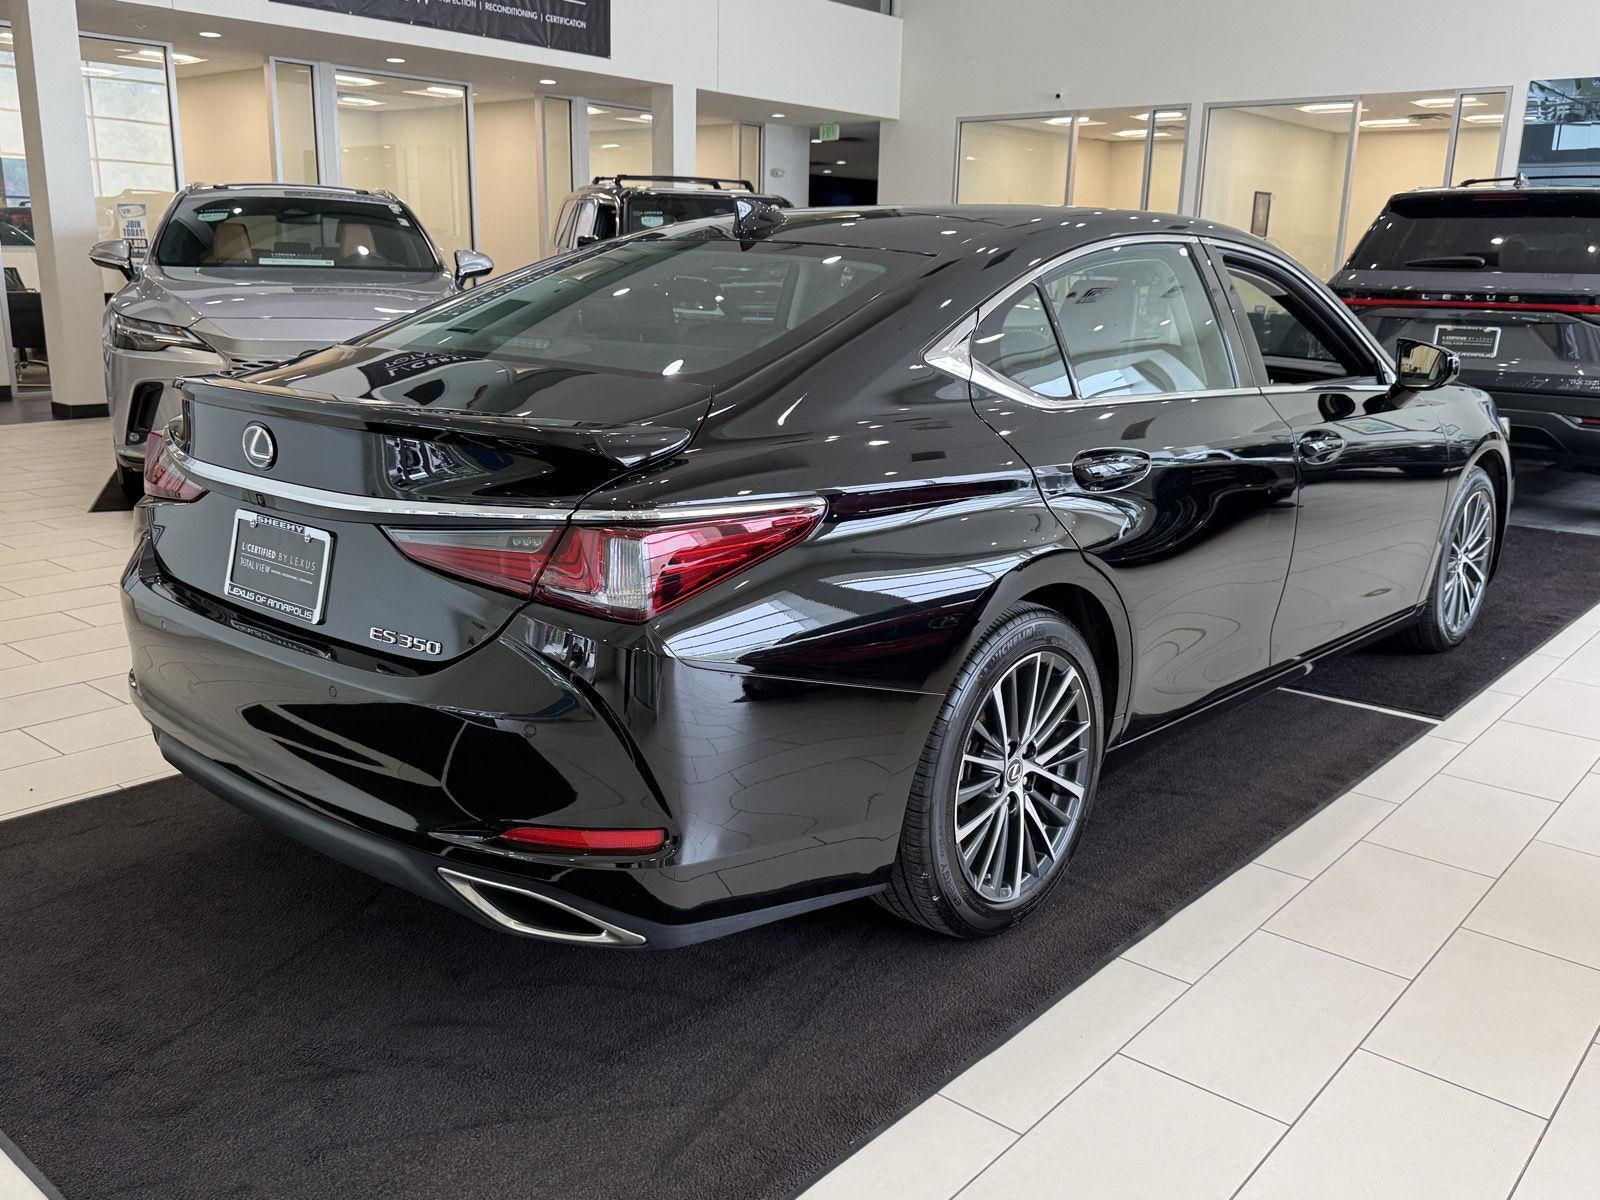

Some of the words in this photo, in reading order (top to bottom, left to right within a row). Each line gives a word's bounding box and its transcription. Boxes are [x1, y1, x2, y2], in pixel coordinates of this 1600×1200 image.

[485, 3, 538, 20] RECONDITIONING
[546, 14, 587, 29] CERTIFICATION
[126, 220, 142, 229] JOIN
[1421, 293, 1519, 302] LEXUS
[257, 515, 304, 533] SHEEHY
[255, 562, 271, 574] VIEW
[278, 553, 288, 562] BY
[290, 556, 316, 571] LEXUS
[228, 585, 255, 600] LEXUS
[255, 592, 267, 604] OF
[267, 598, 312, 620] ANNAPOLIS
[370, 627, 397, 644] ES
[399, 634, 442, 655] 350
[990, 625, 1034, 665] MICHELIN
